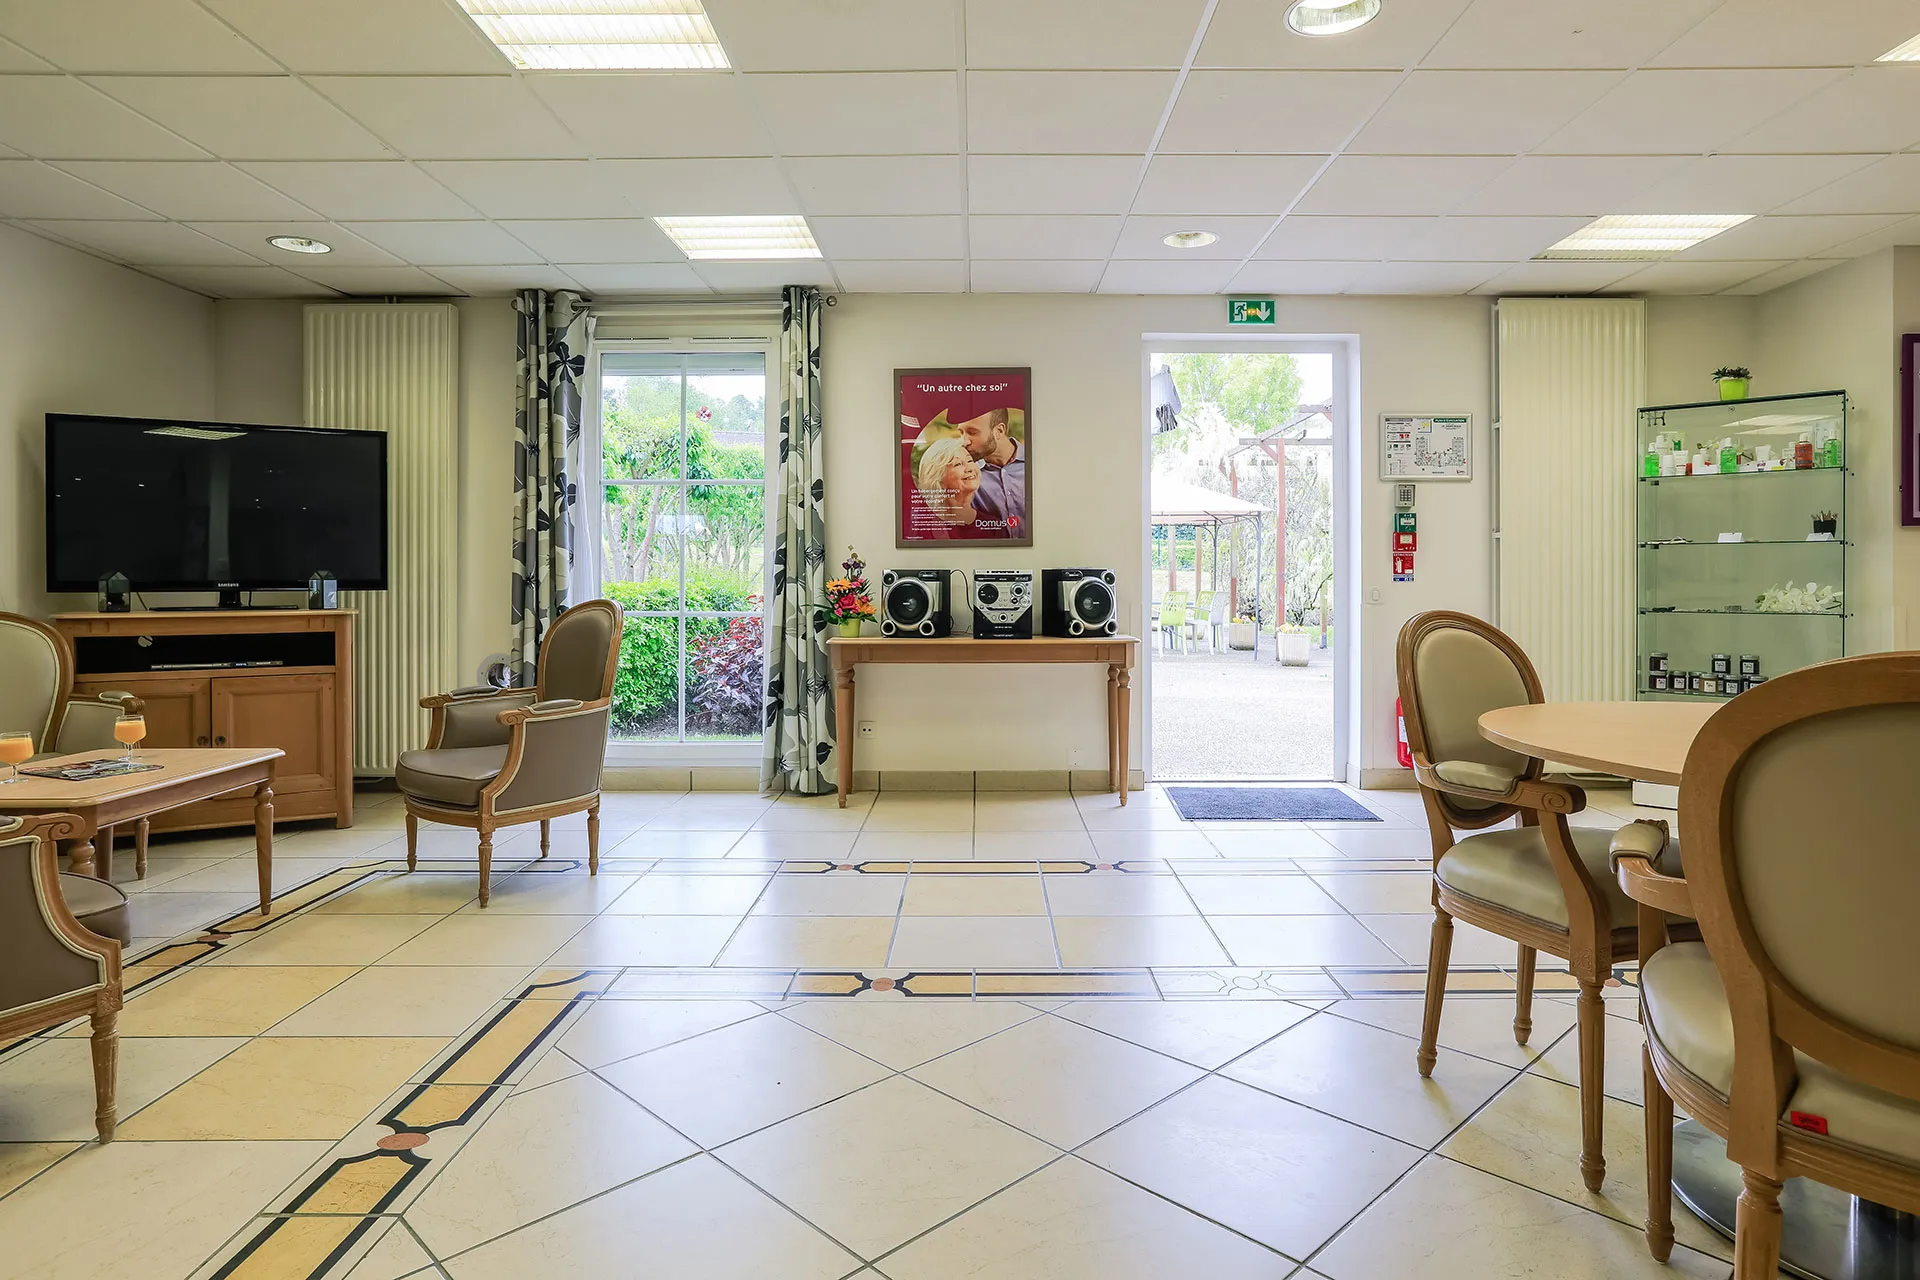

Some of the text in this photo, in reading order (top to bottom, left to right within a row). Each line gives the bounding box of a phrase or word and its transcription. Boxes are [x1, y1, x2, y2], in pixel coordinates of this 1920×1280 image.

[917, 384, 935, 392] “Un
[966, 383, 986, 392] chez
[990, 383, 1008, 392] soi”
